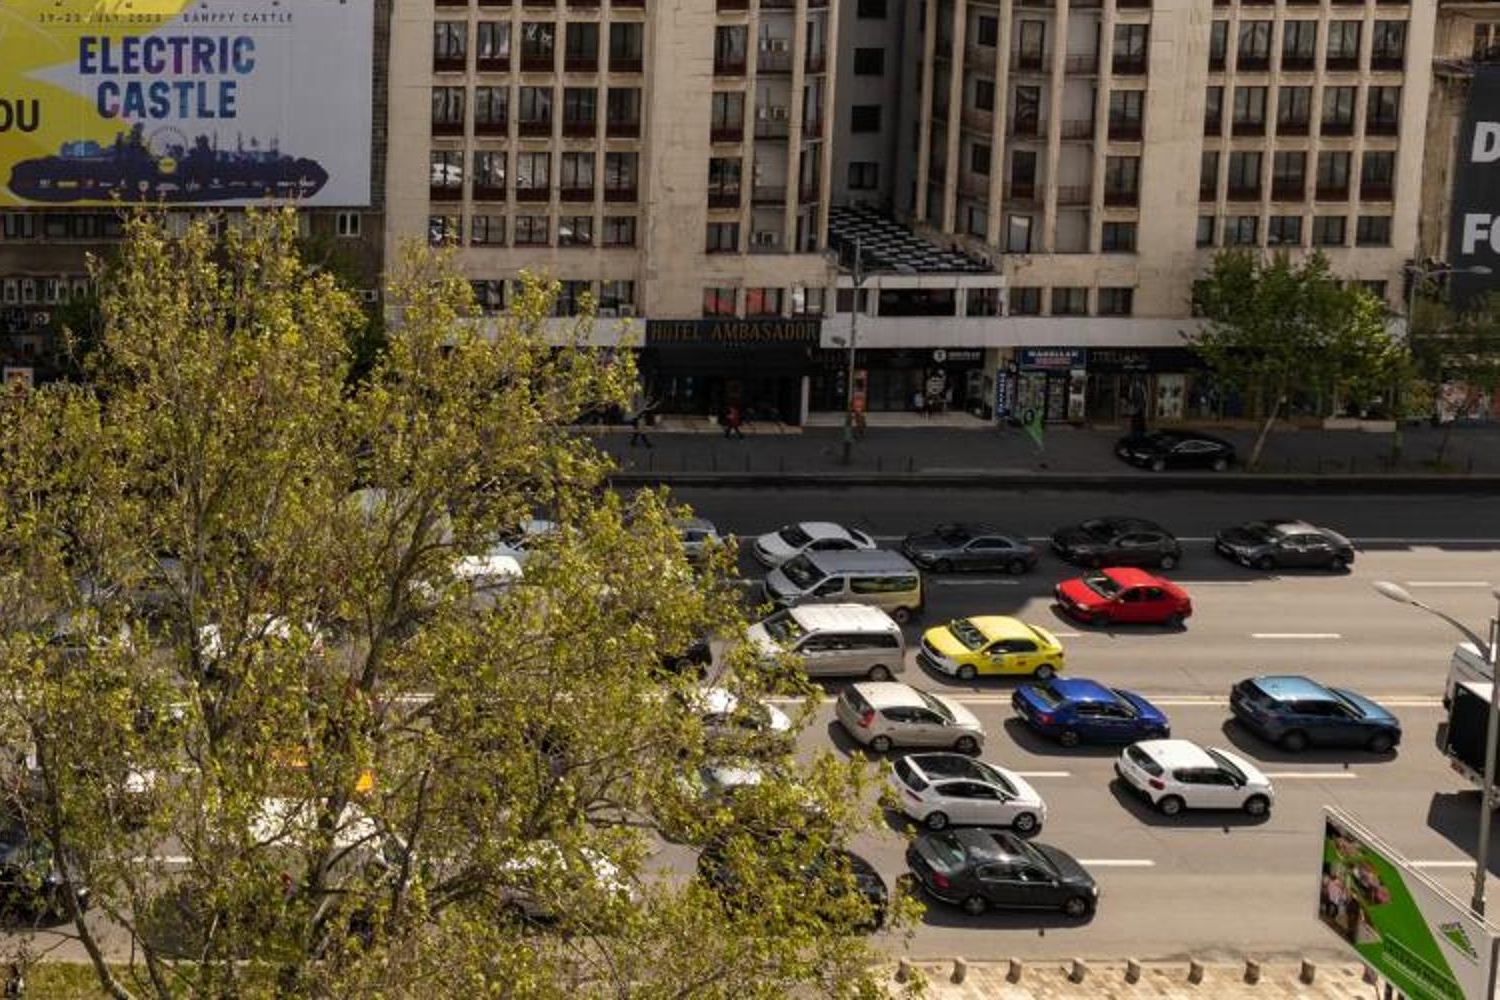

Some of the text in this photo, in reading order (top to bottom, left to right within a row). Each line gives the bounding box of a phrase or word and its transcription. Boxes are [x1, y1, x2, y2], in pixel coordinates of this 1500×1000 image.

[80, 36, 255, 75] ELECTRIC
[97, 81, 237, 119] CASTLE
[651, 322, 817, 341] HOTEL AMBASADOR
